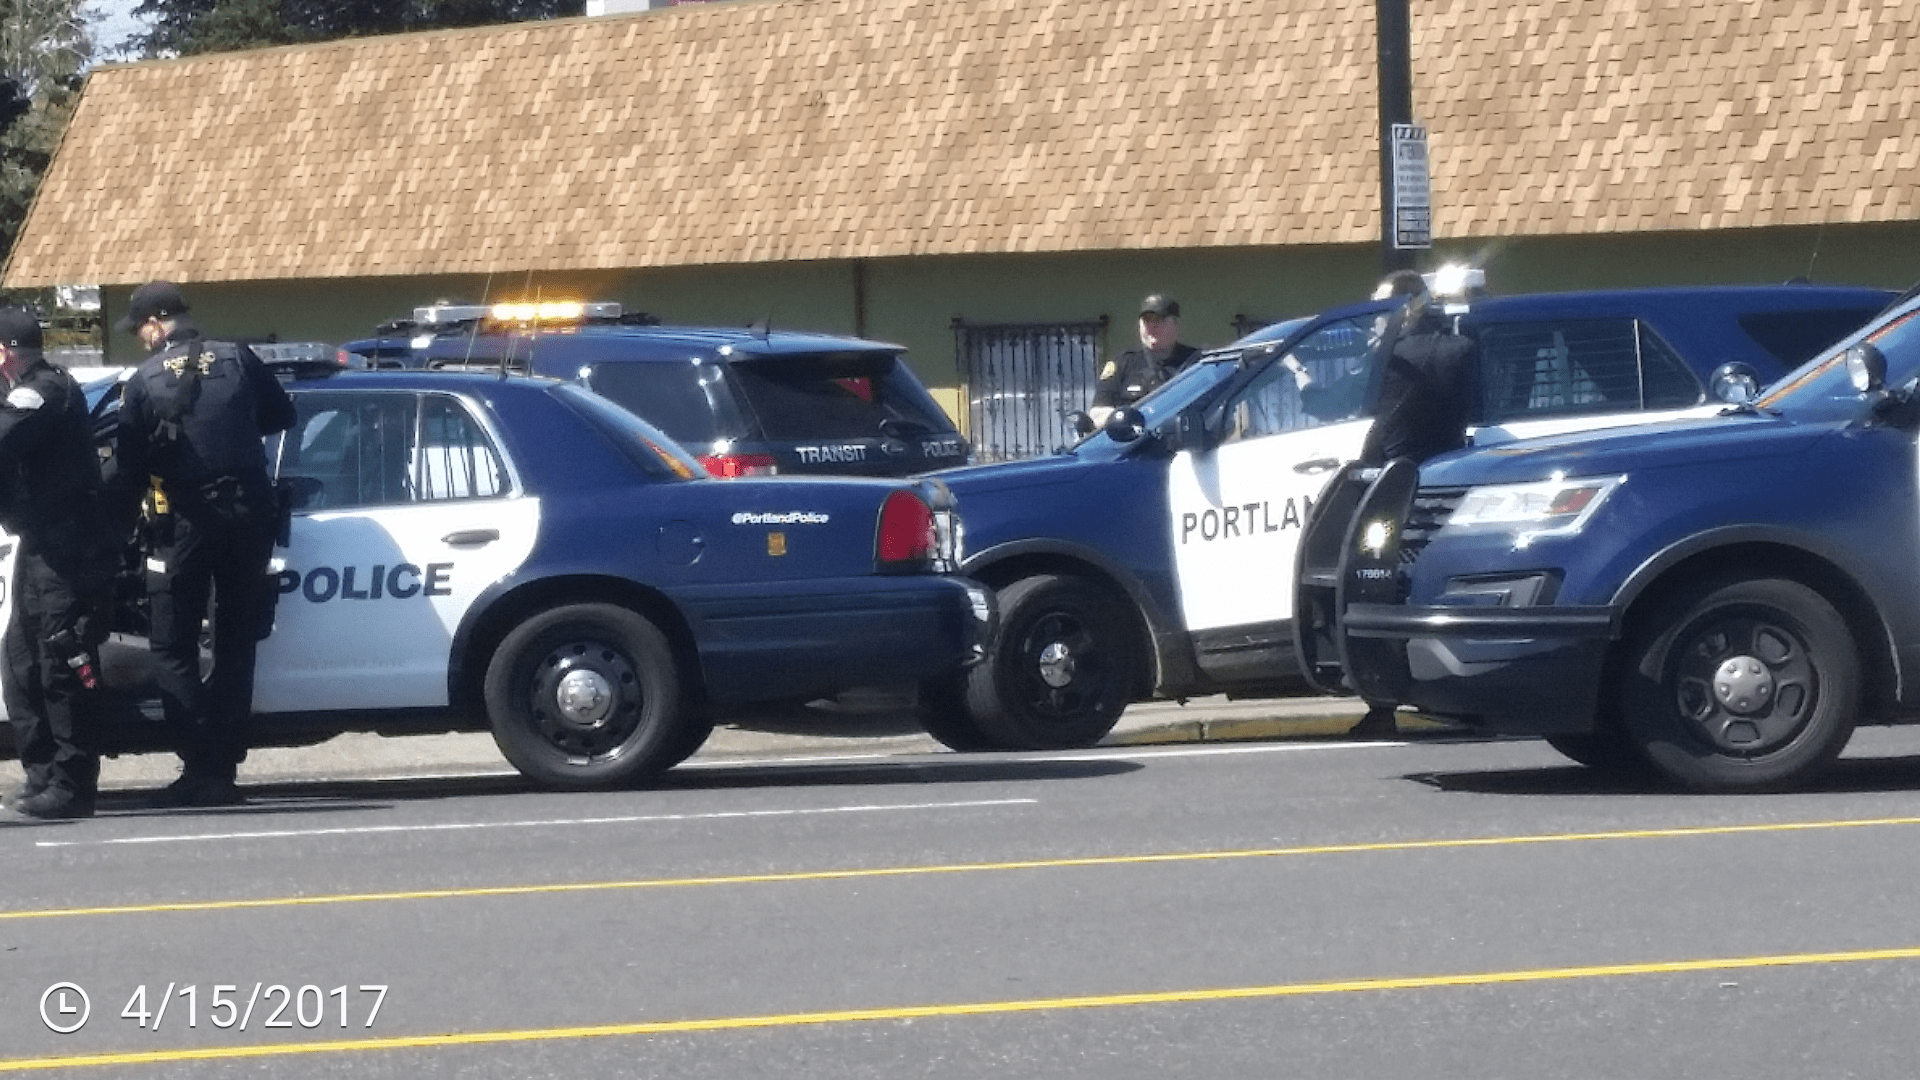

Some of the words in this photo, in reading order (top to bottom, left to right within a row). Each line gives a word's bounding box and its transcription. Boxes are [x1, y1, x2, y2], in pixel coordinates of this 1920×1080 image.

[795, 444, 866, 464] TRANSIT
[921, 440, 961, 458] POLICE
[732, 511, 829, 524] @PortlandPolice
[277, 561, 455, 603] POLICE
